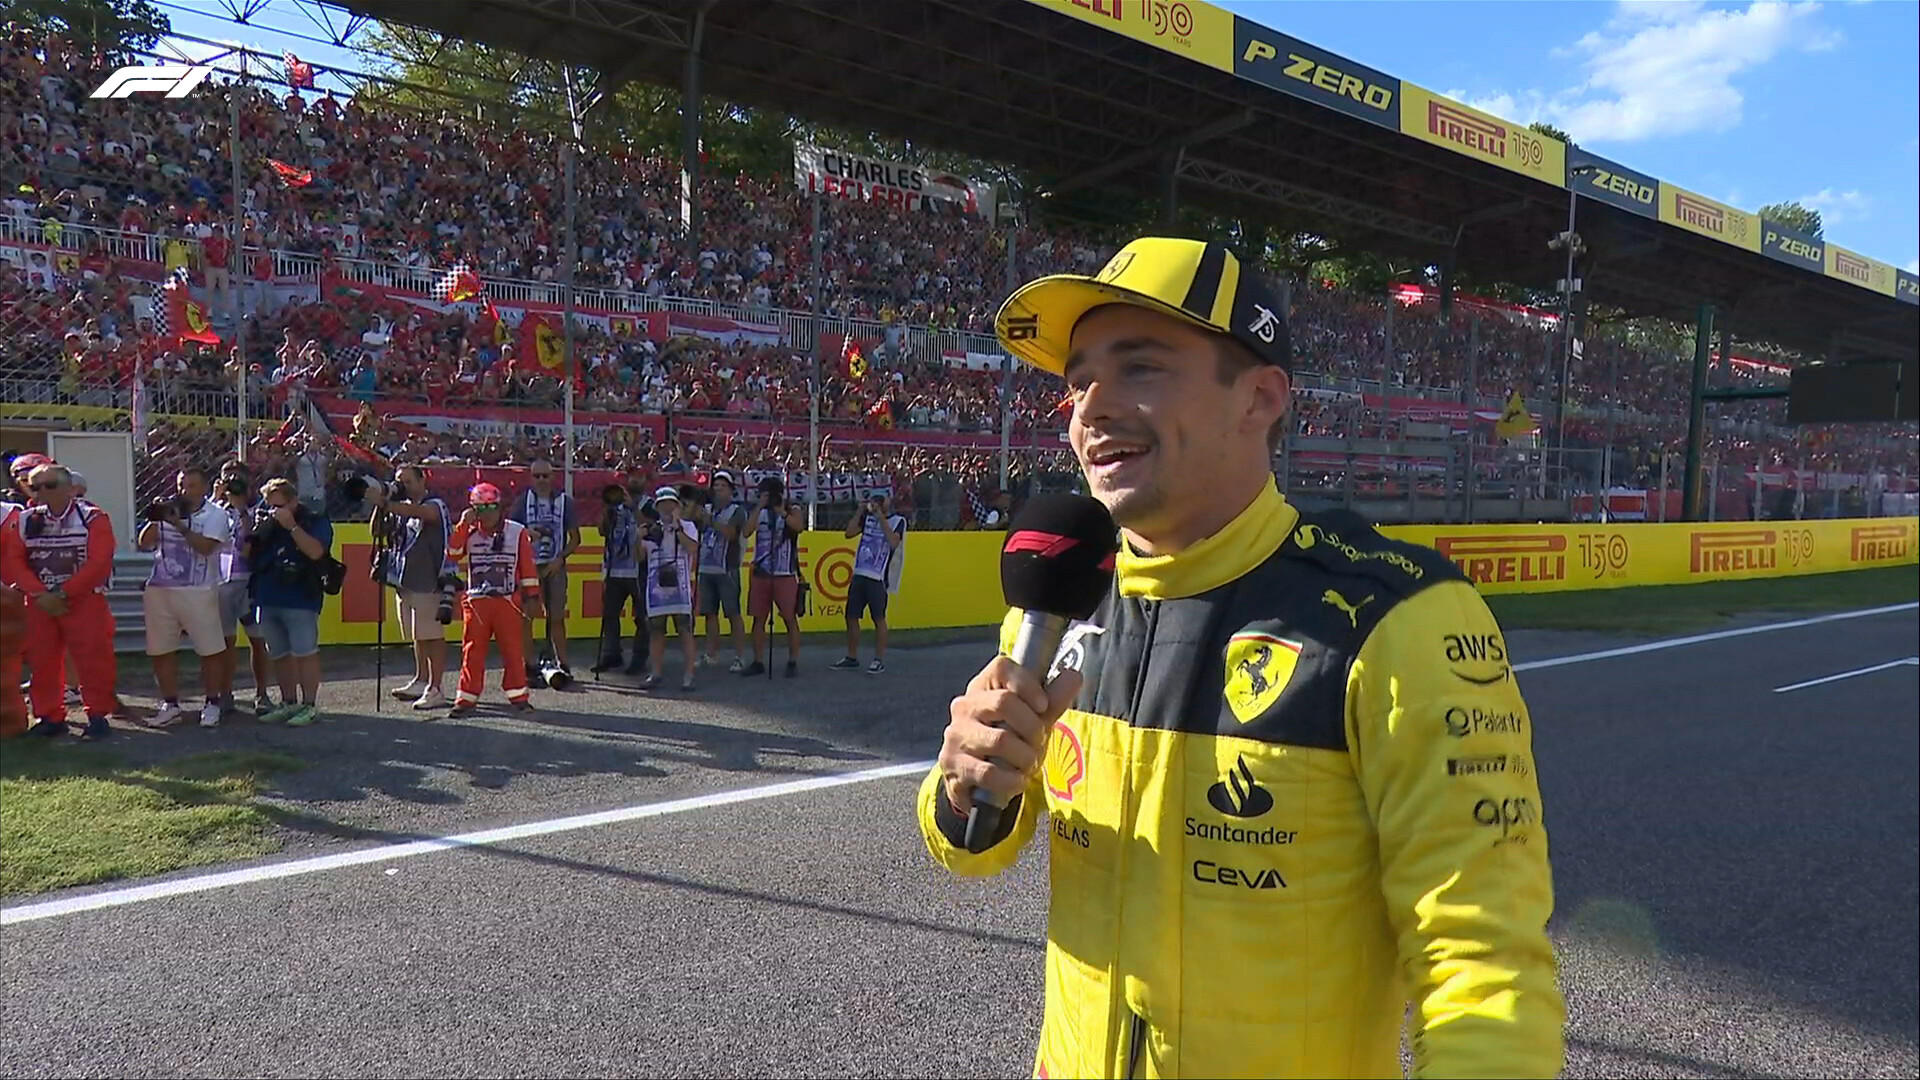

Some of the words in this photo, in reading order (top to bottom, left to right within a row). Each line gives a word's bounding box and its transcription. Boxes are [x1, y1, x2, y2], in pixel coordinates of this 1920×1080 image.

[1243, 39, 1276, 63] P
[1283, 53, 1392, 111] ZERO
[1429, 100, 1506, 158] PIRELLI
[823, 154, 923, 191] CHARLES
[1592, 168, 1655, 204] ZERO
[1676, 193, 1723, 233] PIRELLI
[1764, 231, 1777, 245] P
[1779, 236, 1823, 262] ZERO
[1836, 251, 1869, 282] PIRELLI
[1898, 278, 1908, 291] P
[1579, 534, 1628, 579] 150
[1690, 531, 1776, 572] PIRELLI
[1851, 525, 1907, 561] PIRELLI
[818, 605, 846, 617] YEA
[1443, 634, 1504, 662] aws
[1185, 818, 1297, 844] Santander
